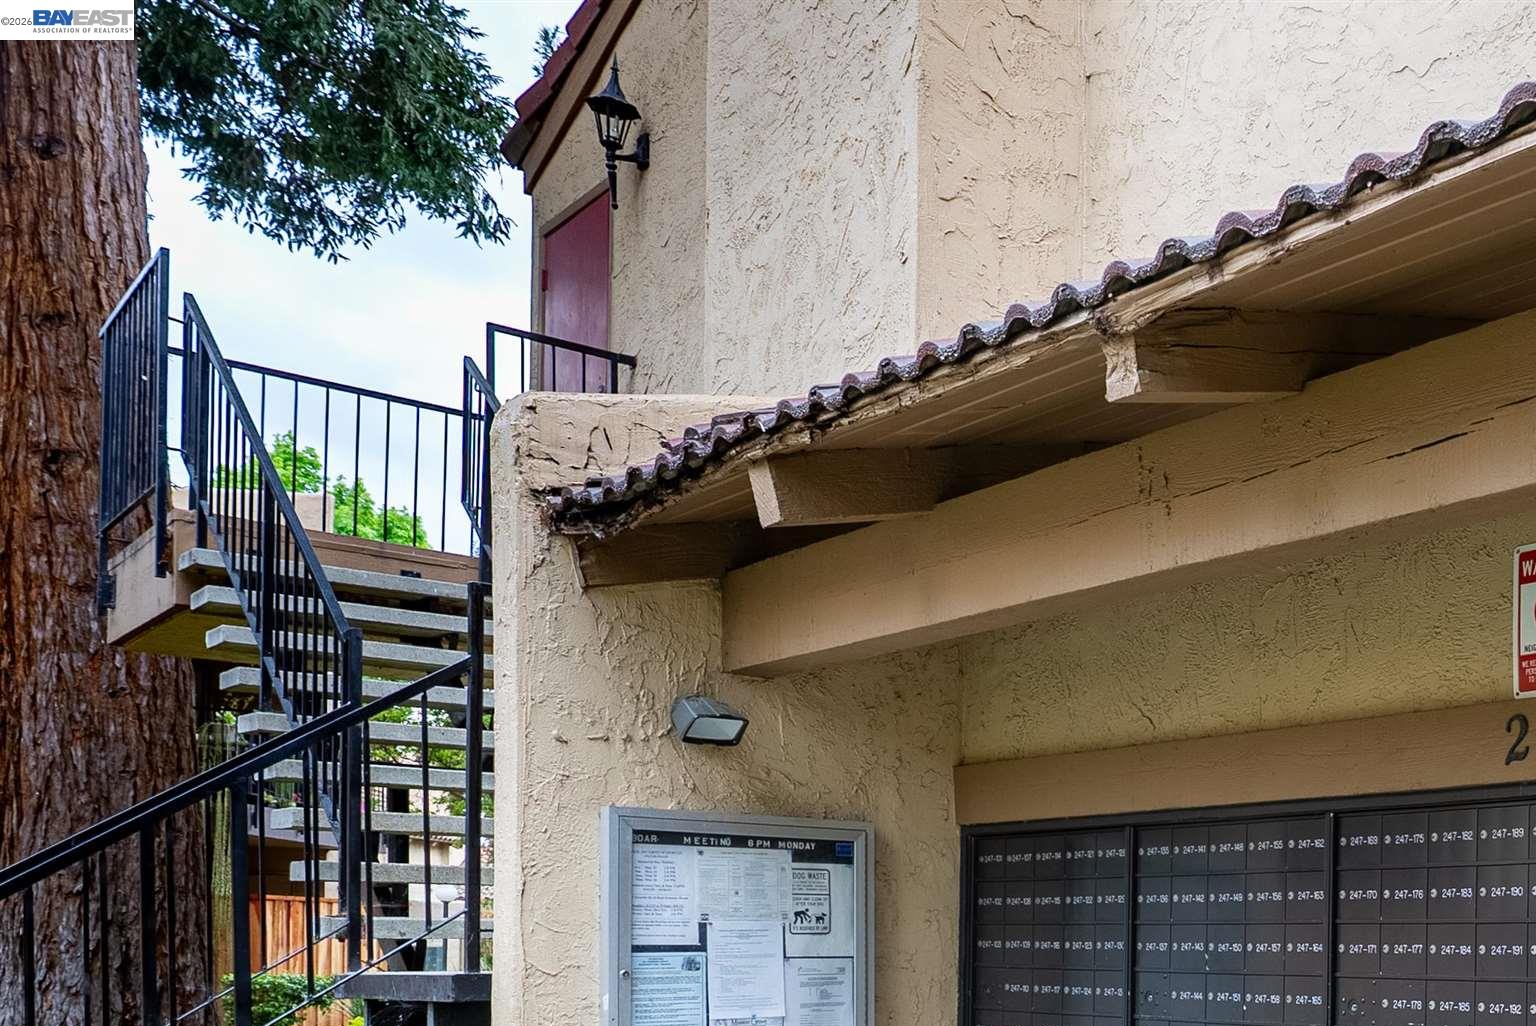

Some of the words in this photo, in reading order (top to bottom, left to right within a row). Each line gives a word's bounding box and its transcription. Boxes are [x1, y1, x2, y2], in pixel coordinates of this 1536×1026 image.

[1522, 660, 1529, 668] WE
[1528, 675, 1535, 683] TO
[1492, 828, 1524, 839] 247-189
[1396, 834, 1424, 844] 247-175
[778, 840, 816, 851] MONDAY
[807, 872, 827, 881] WASTE
[1350, 890, 1377, 899] 247-170
[1395, 890, 1423, 899] 247-176
[1350, 945, 1376, 953] 247-171
[1394, 944, 1422, 953] 247-177
[1491, 946, 1522, 955] 247-191
[1393, 1000, 1422, 1009] 247-178
[1490, 1004, 1521, 1014] 247-192
